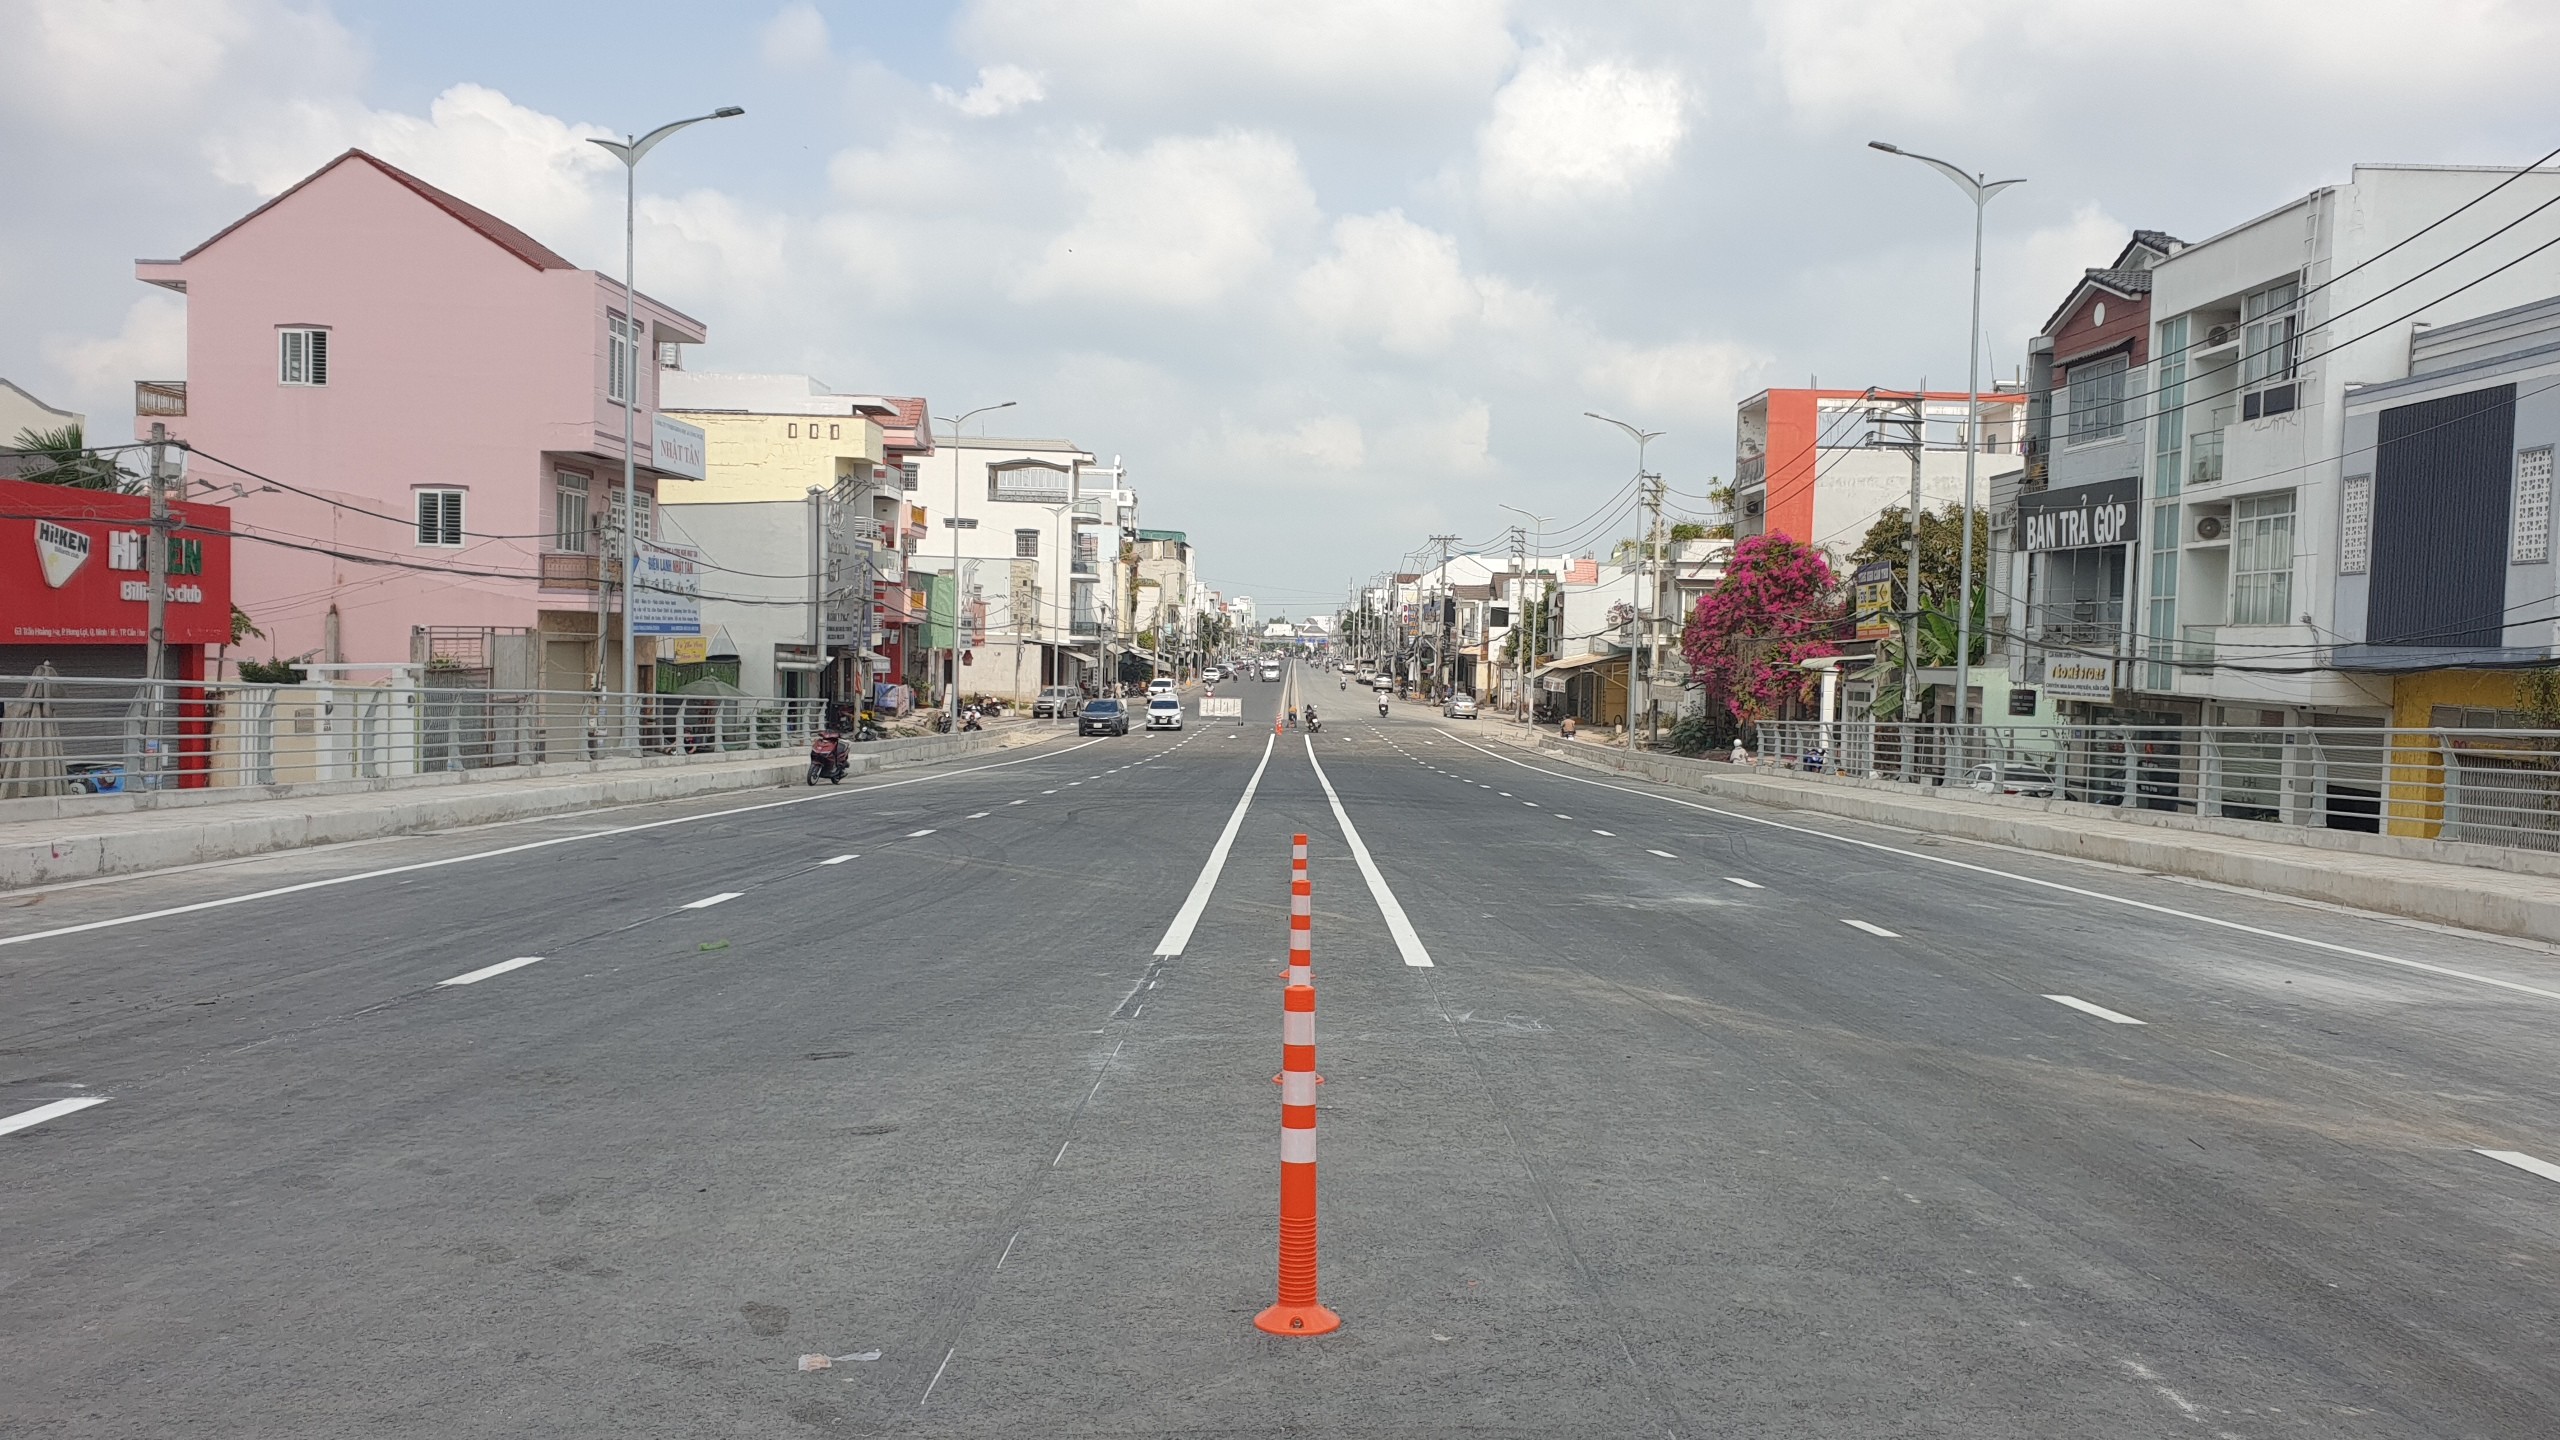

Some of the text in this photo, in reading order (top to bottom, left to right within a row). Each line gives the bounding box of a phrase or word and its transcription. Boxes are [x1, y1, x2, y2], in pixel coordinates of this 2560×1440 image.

[661, 438, 700, 467] NHẬT TÂN
[2027, 494, 2126, 550] BÁN TRẢ GÓP
